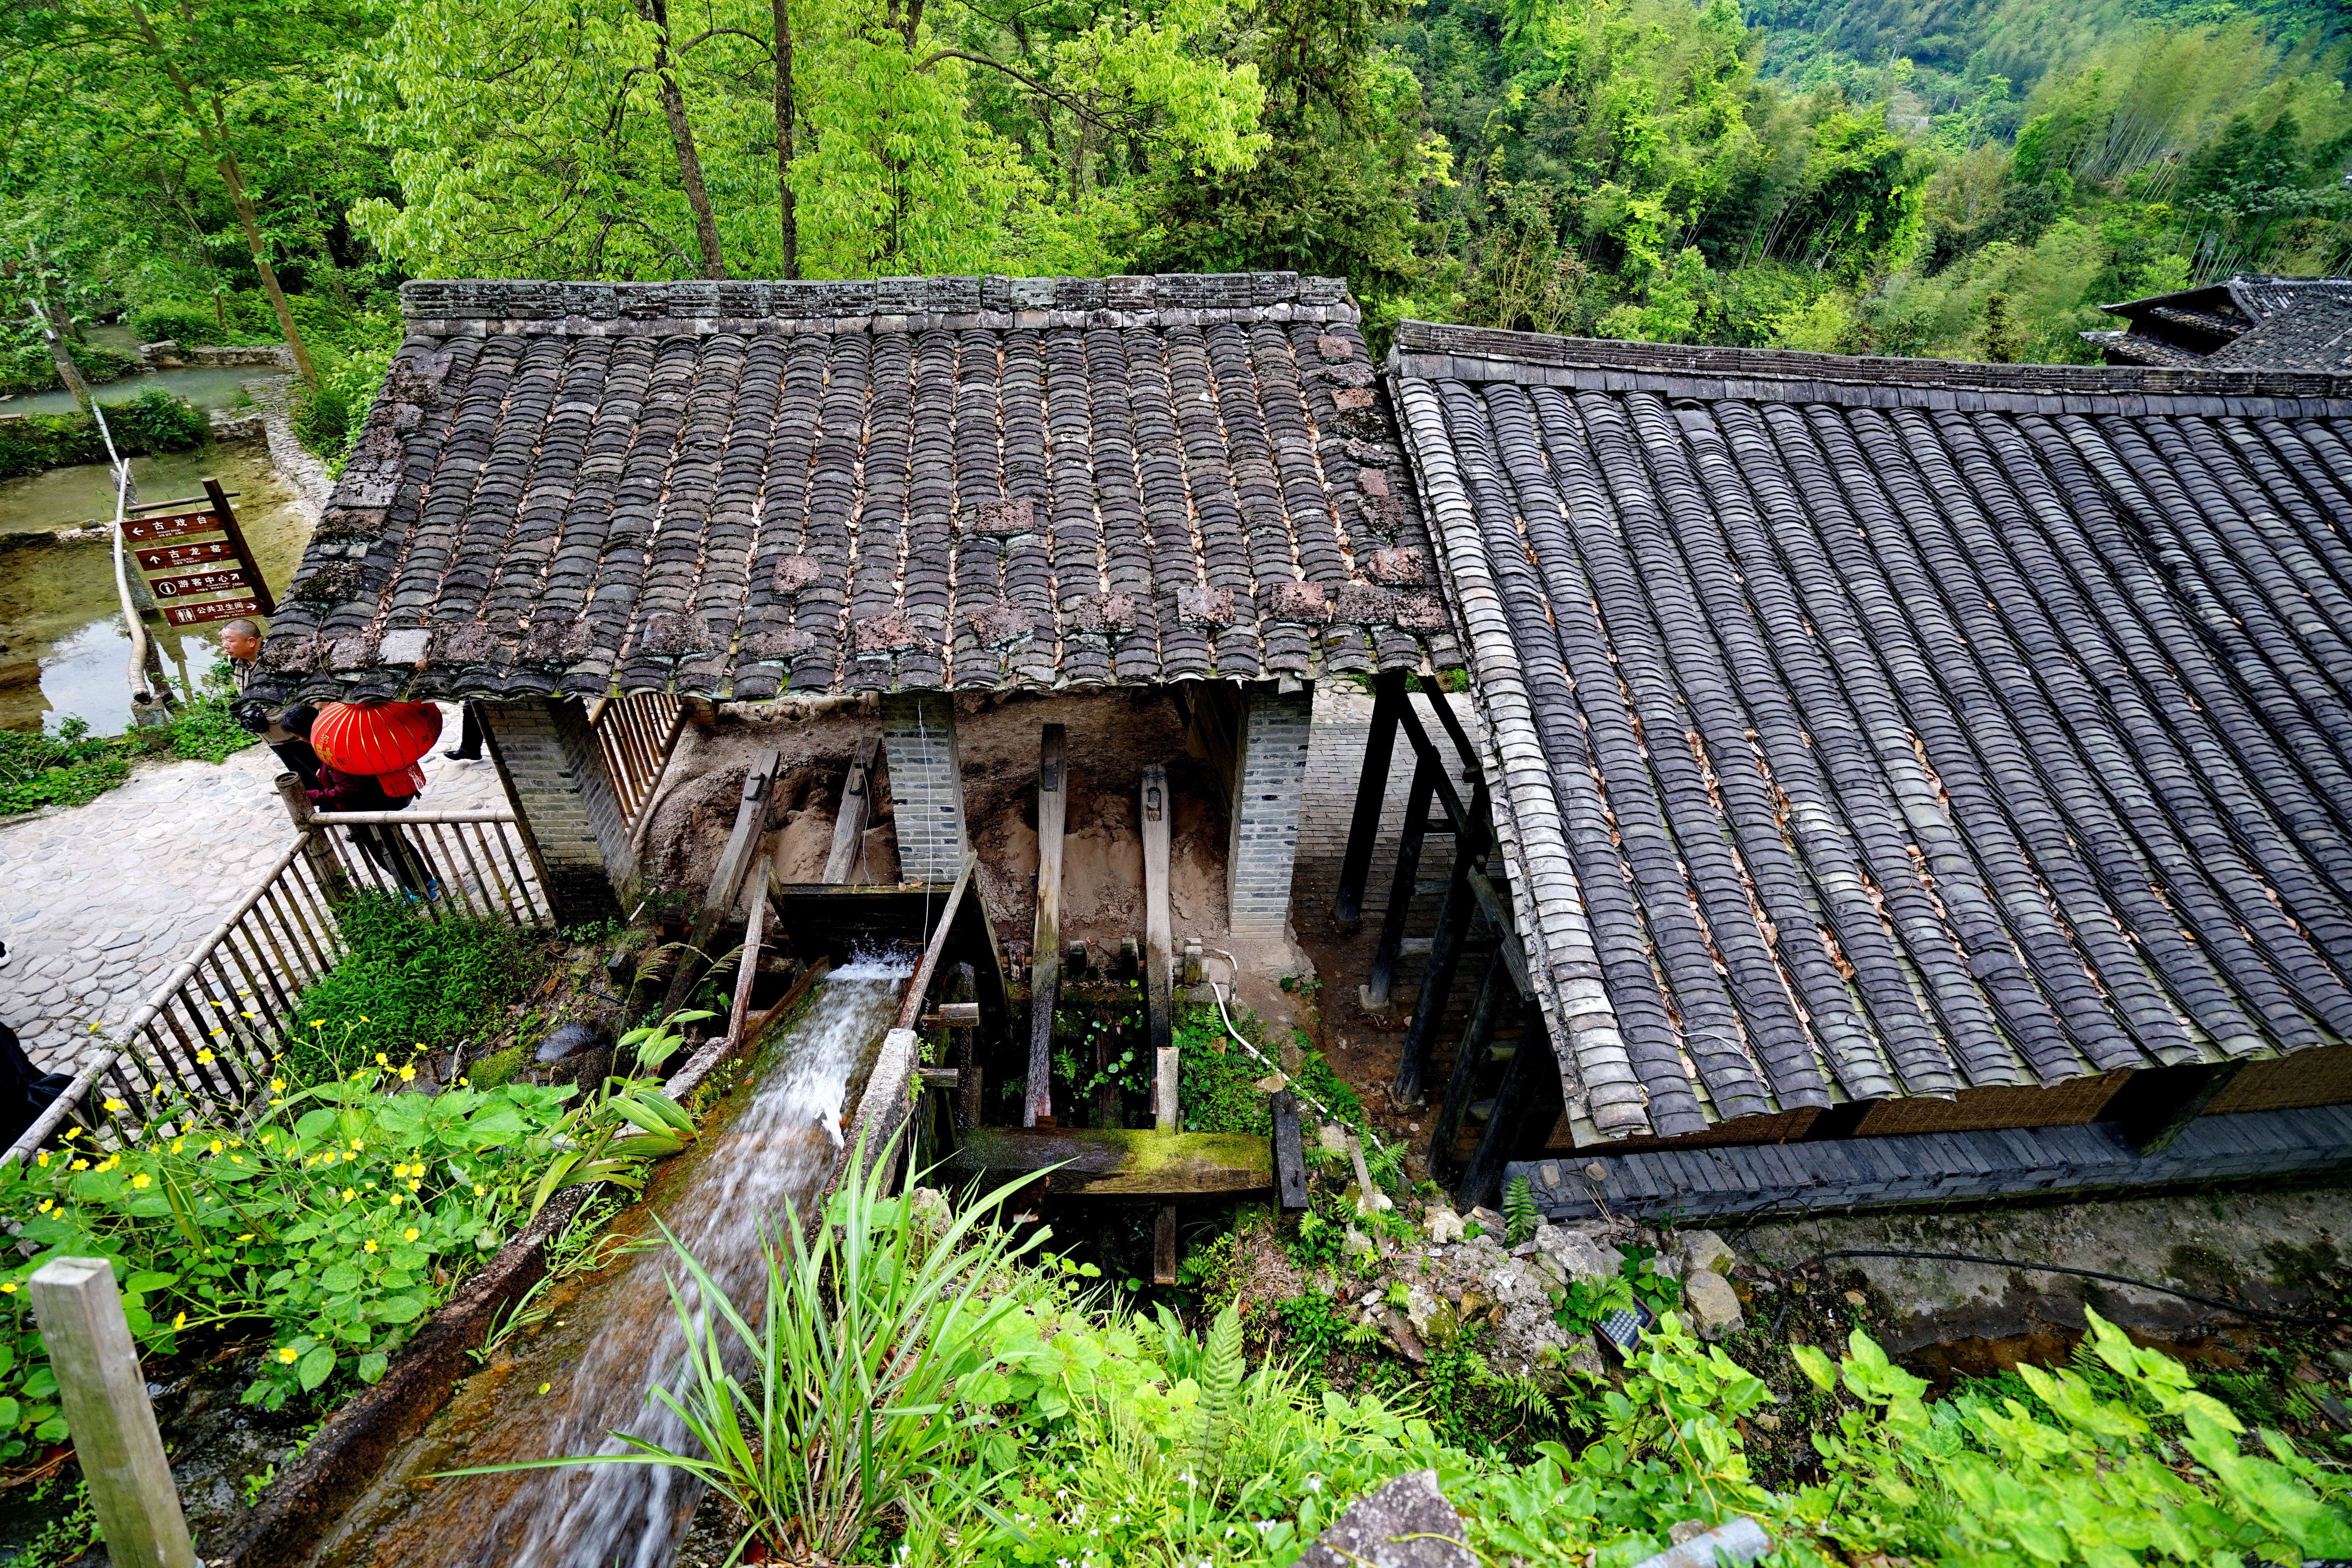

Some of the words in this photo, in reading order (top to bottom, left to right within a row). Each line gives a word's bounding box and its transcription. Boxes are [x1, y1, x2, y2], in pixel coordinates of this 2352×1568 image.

[152, 515, 207, 530] 古戏台
[168, 544, 221, 559] 古龙窑
[177, 575, 228, 588] 游客中心
[197, 602, 243, 614] 公共卫生间
